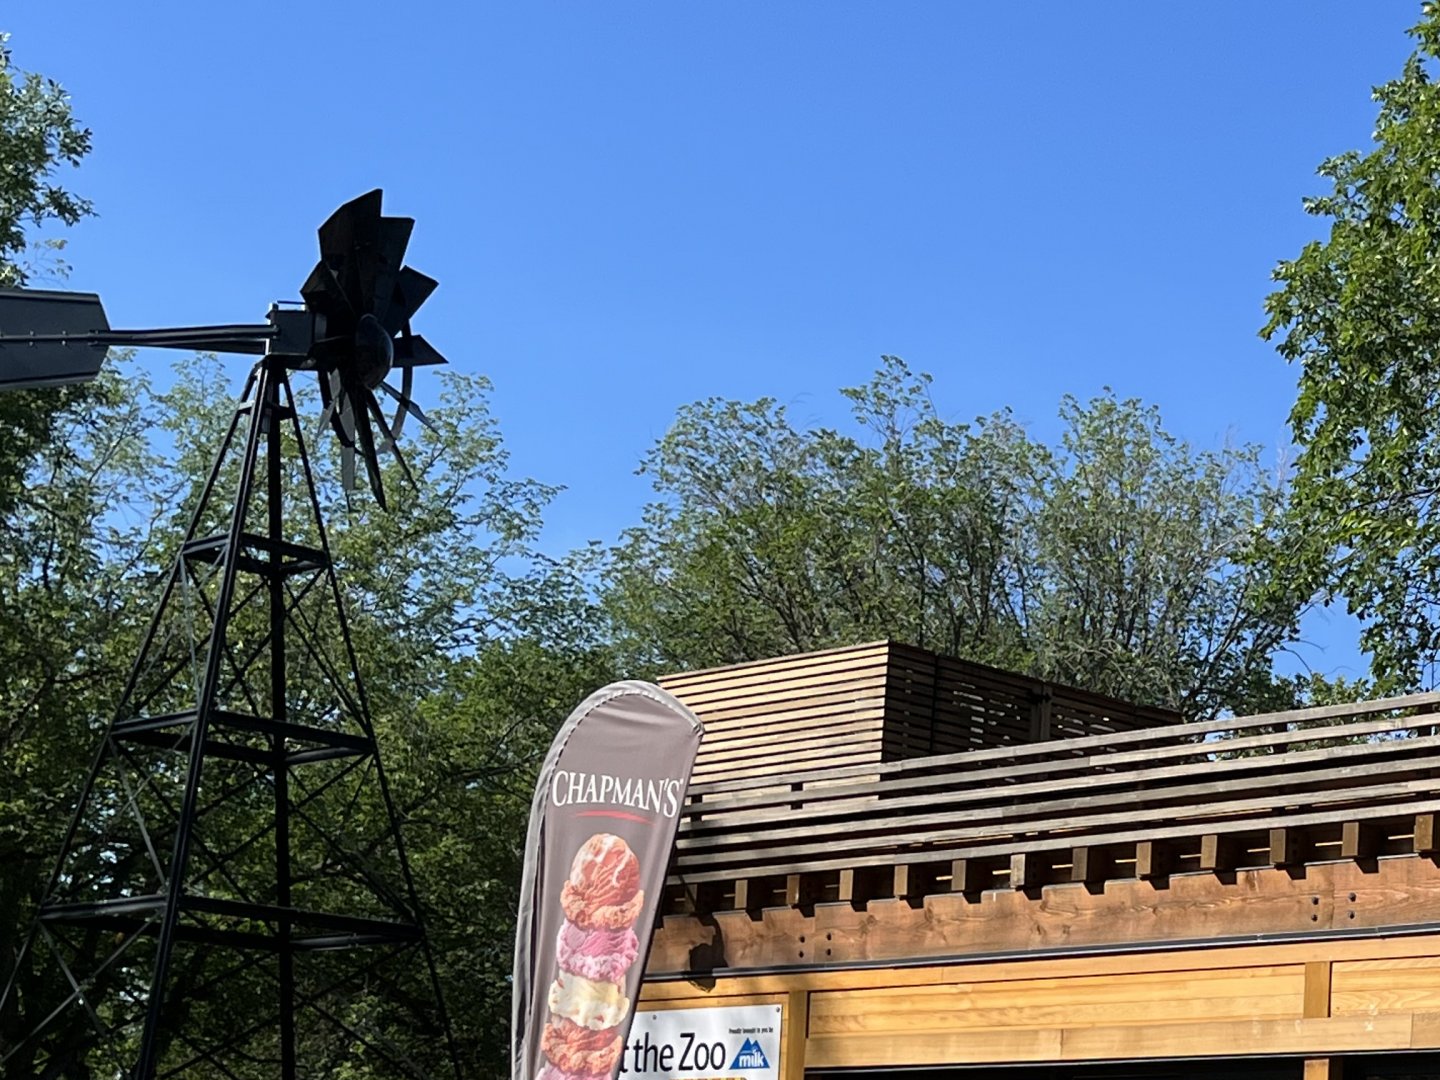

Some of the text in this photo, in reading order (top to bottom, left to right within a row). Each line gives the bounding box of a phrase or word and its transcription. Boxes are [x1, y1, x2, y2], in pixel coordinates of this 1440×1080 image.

[551, 769, 681, 818] CHAPMAN'S
[633, 1032, 673, 1073] the
[678, 1032, 726, 1071] Zoo
